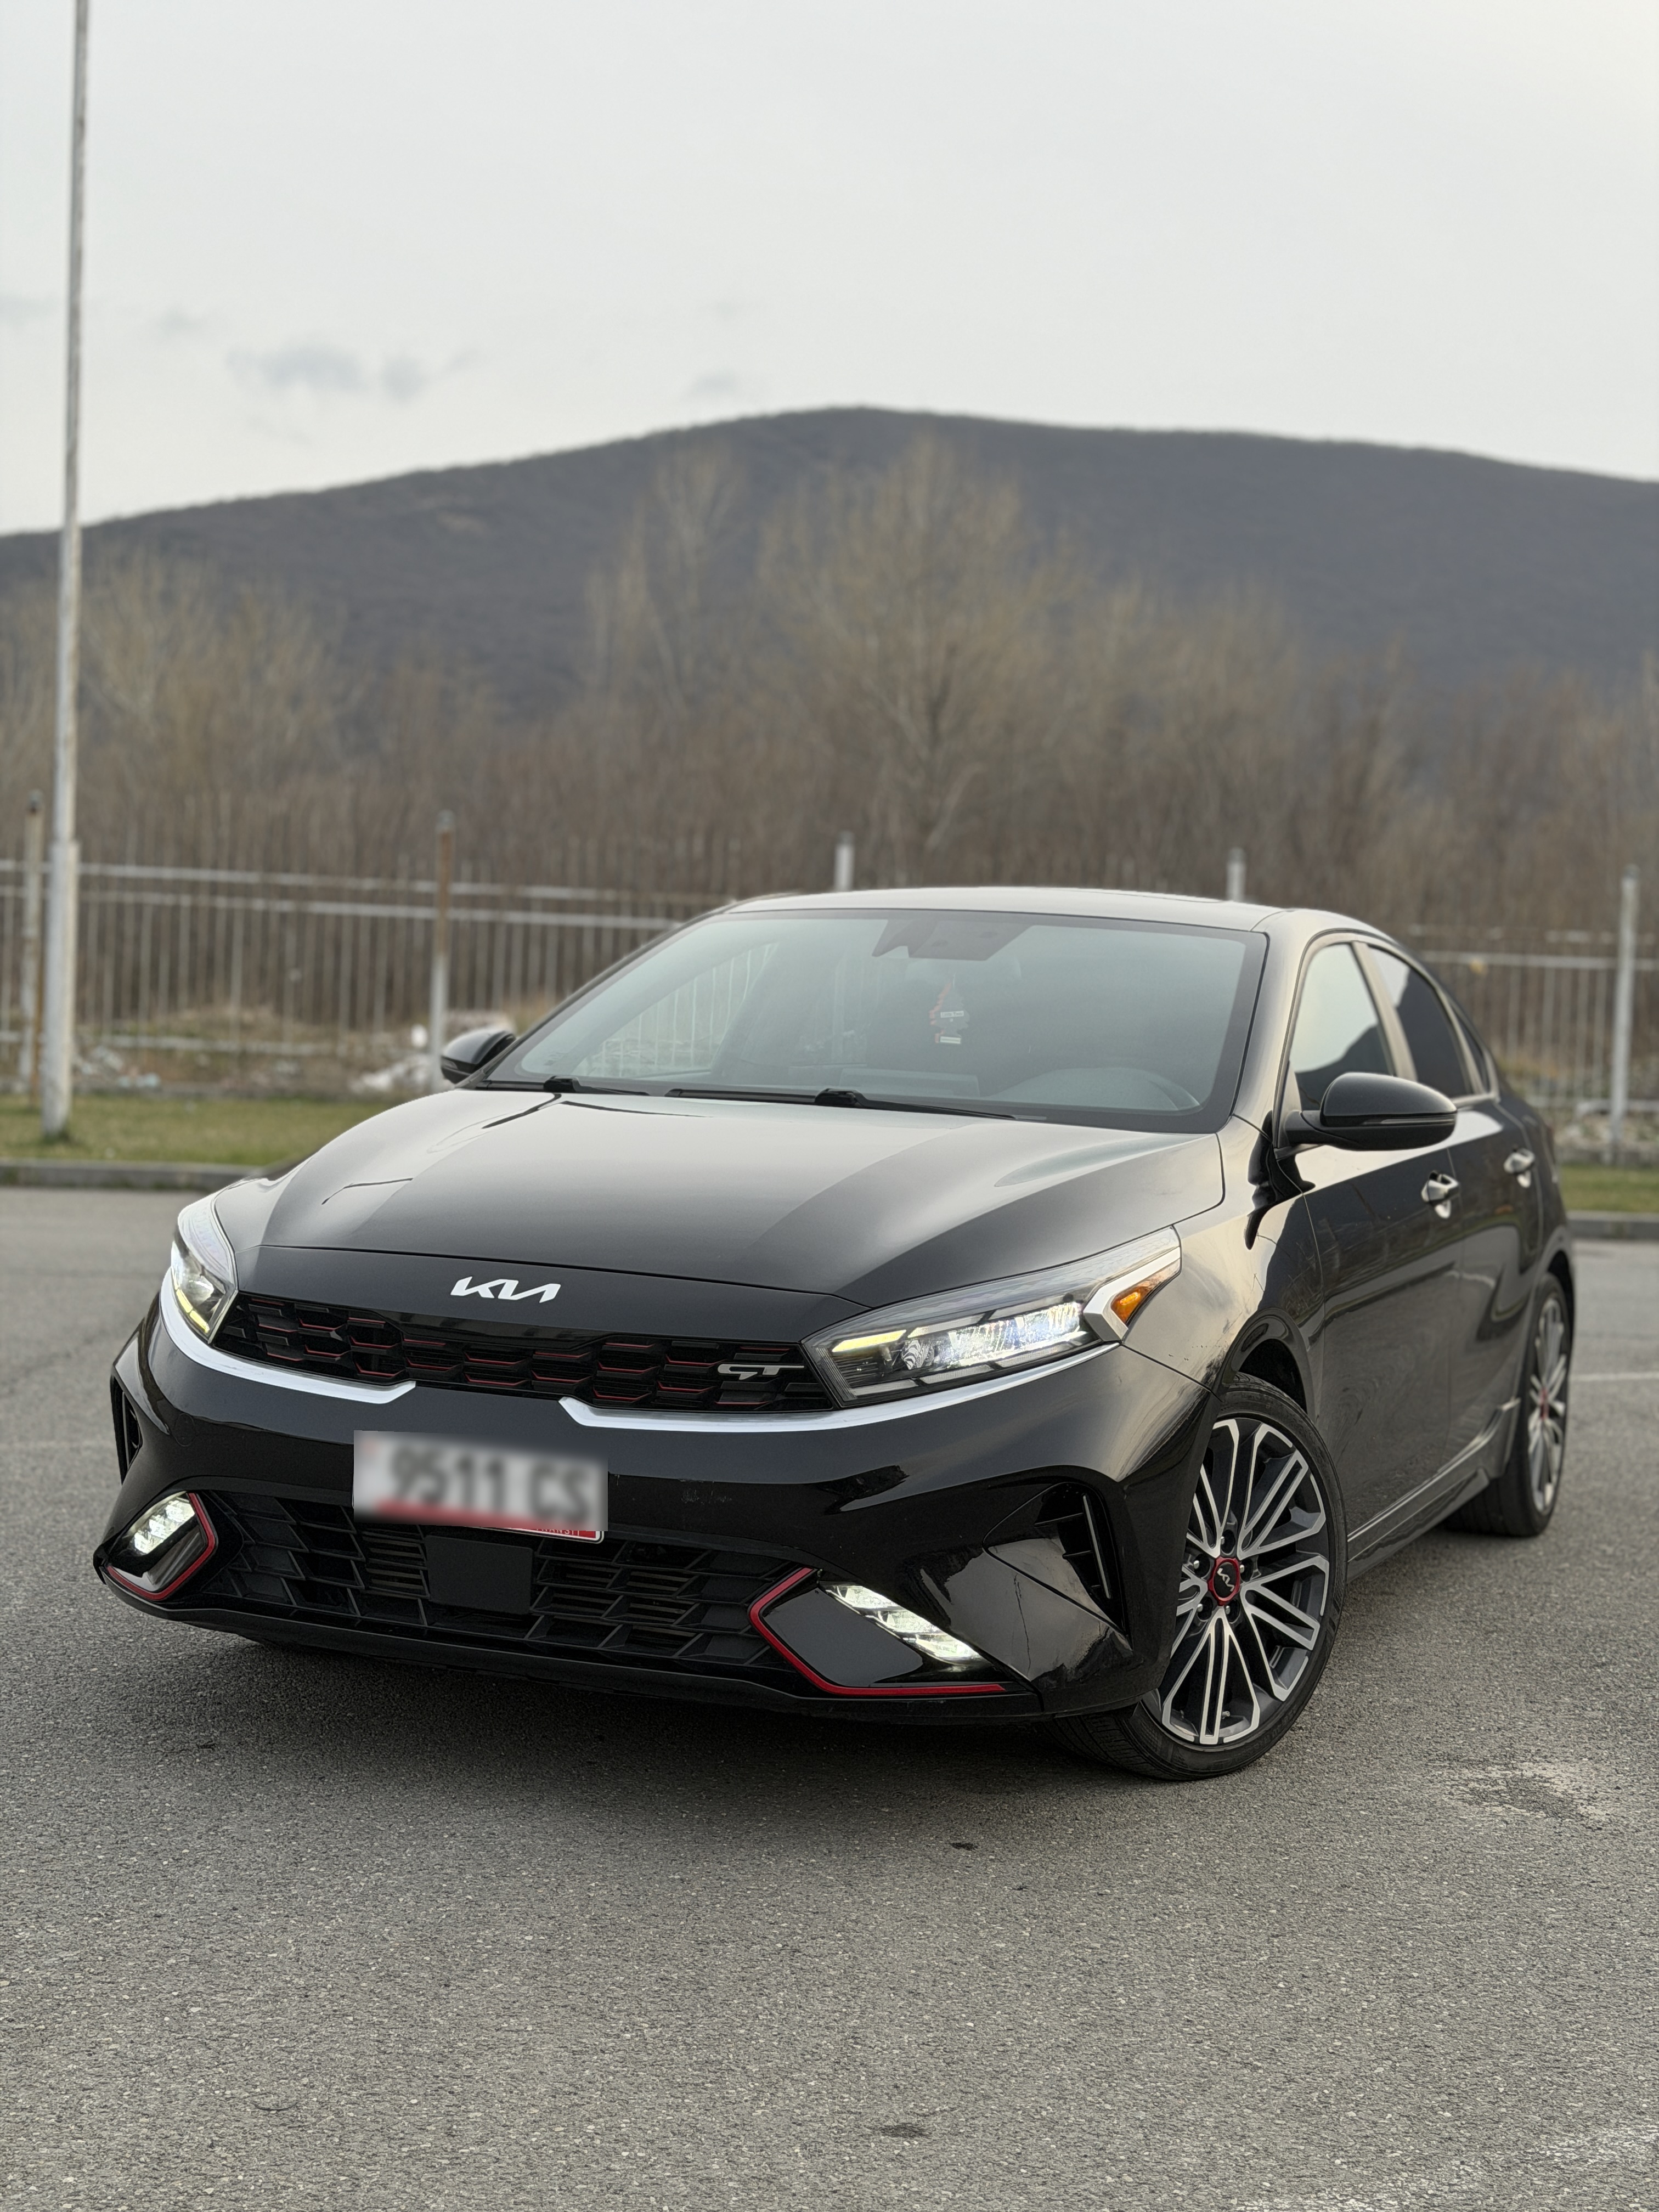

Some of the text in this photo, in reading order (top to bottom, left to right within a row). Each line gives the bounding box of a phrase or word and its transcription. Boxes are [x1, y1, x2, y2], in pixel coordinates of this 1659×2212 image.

[450, 1276, 561, 1304] KIA
[718, 1364, 805, 1380] GT
[1217, 1567, 1235, 1592] KIA
